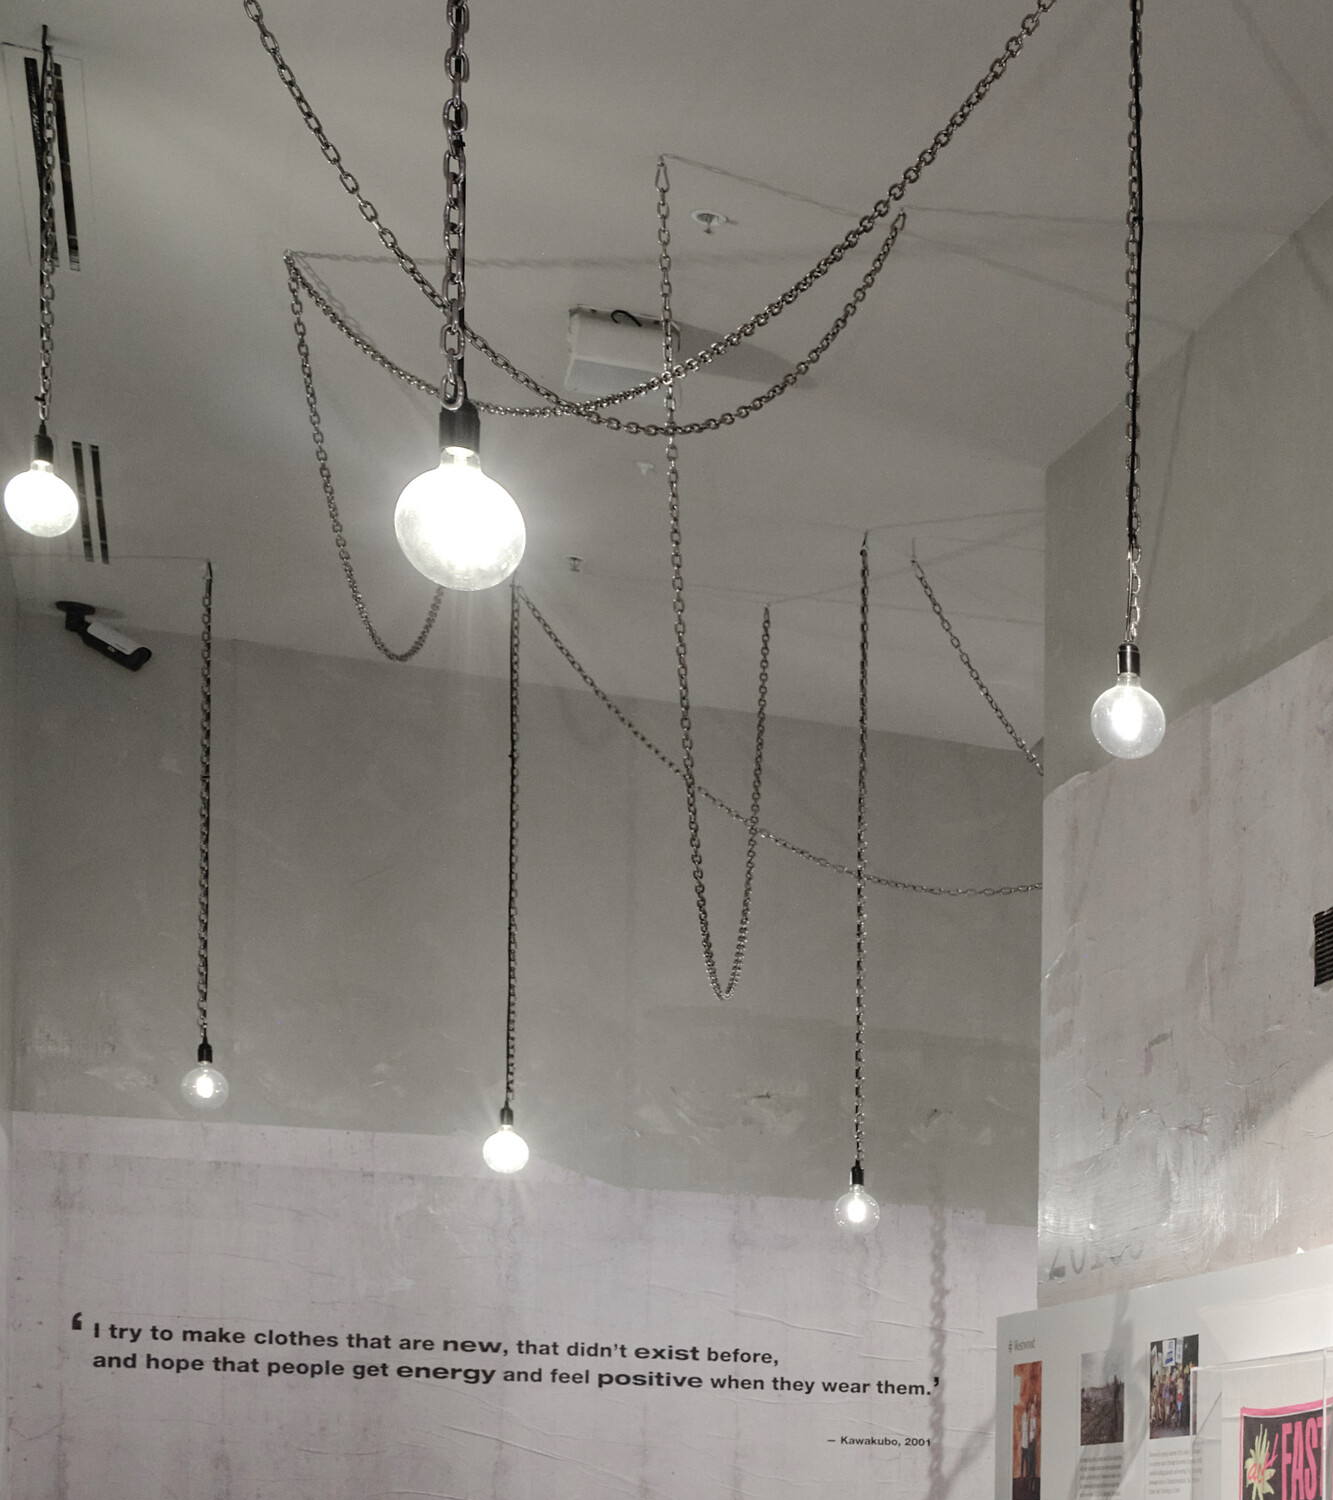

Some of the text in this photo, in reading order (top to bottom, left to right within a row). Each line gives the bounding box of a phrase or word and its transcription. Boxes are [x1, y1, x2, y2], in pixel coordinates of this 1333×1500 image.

[109, 1324, 142, 1343] try
[150, 1326, 173, 1341] to
[183, 1328, 245, 1343] make
[254, 1330, 338, 1347] clothes
[347, 1333, 391, 1349] that
[399, 1339, 434, 1350] are
[443, 1340, 508, 1356] new,
[516, 1340, 558, 1355] that
[567, 1342, 627, 1358] didn’t
[635, 1345, 699, 1361] exist
[708, 1347, 778, 1366] before,
[93, 1353, 136, 1368] and
[147, 1354, 204, 1373] hope
[212, 1357, 259, 1372] that
[268, 1360, 344, 1378] people
[353, 1363, 388, 1379] get
[397, 1366, 496, 1384] energy
[503, 1368, 542, 1382] and
[550, 1369, 589, 1384] feel
[598, 1372, 702, 1388] positive
[711, 1375, 764, 1390] when
[772, 1377, 814, 1394] they
[822, 1382, 870, 1393] wear
[841, 1436, 901, 1446] Kawakubo,
[905, 1438, 930, 1446] 2001
